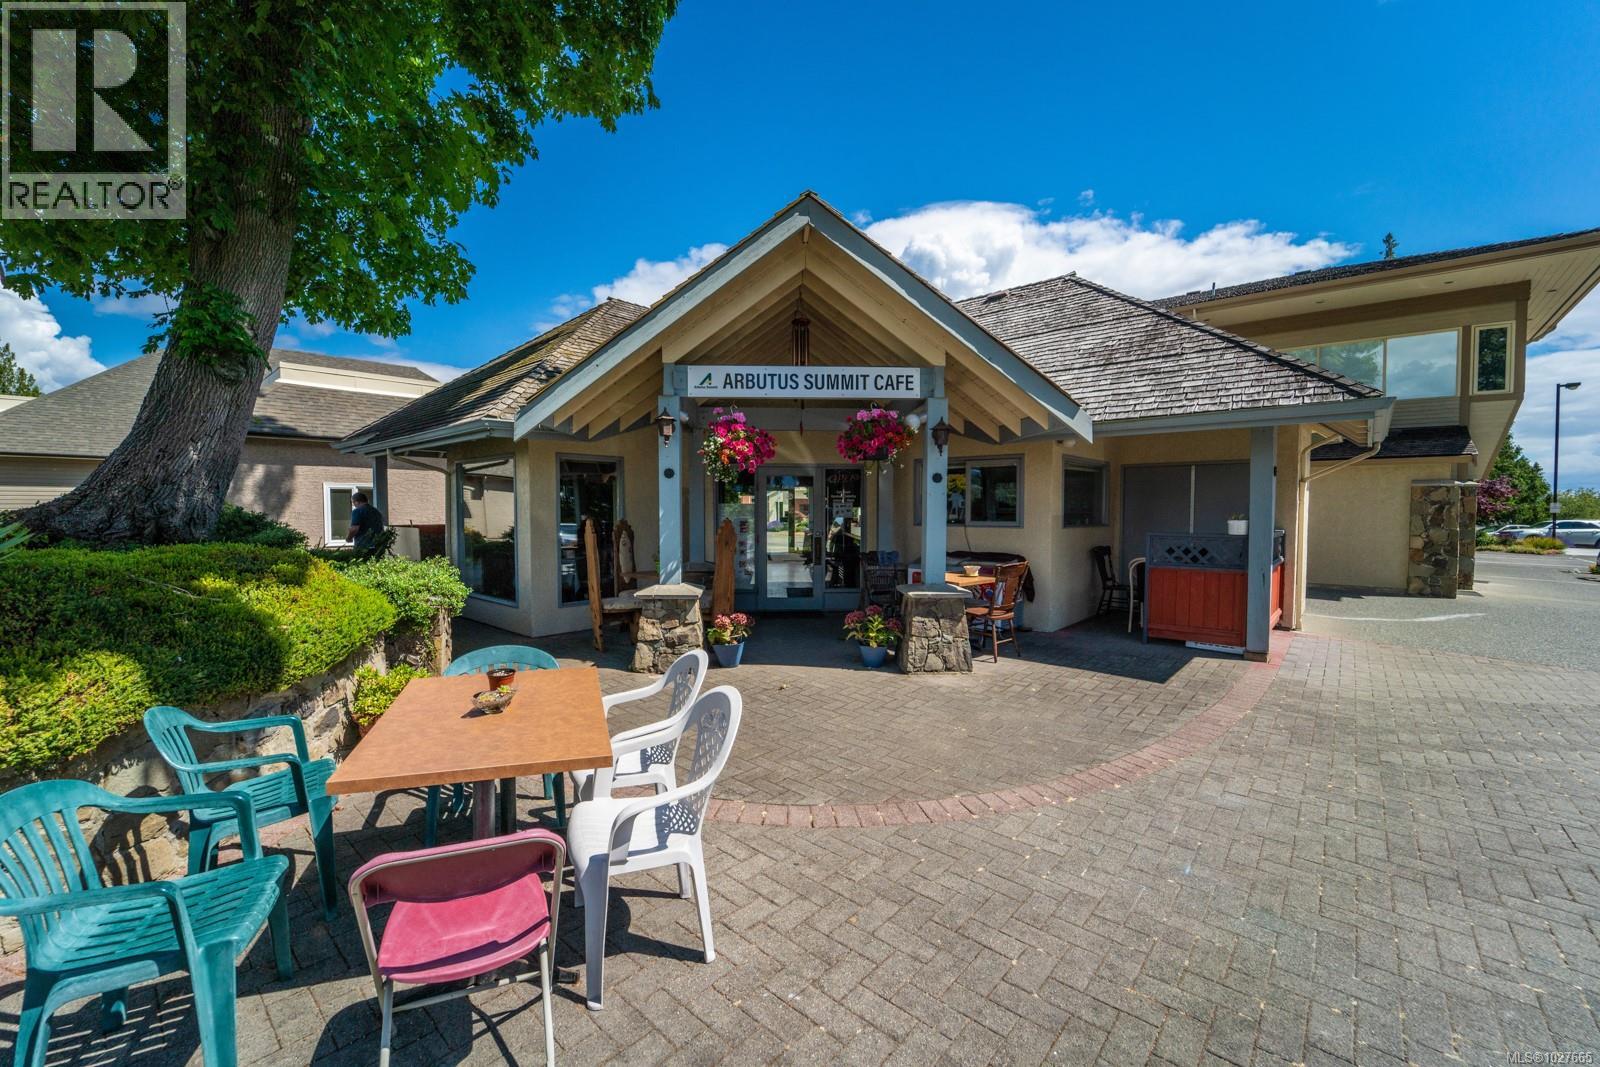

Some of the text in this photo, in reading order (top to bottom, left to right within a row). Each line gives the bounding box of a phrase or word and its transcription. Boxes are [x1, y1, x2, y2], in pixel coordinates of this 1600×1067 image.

[722, 373, 914, 391] ARBUTUS SUMMIT CAFE
